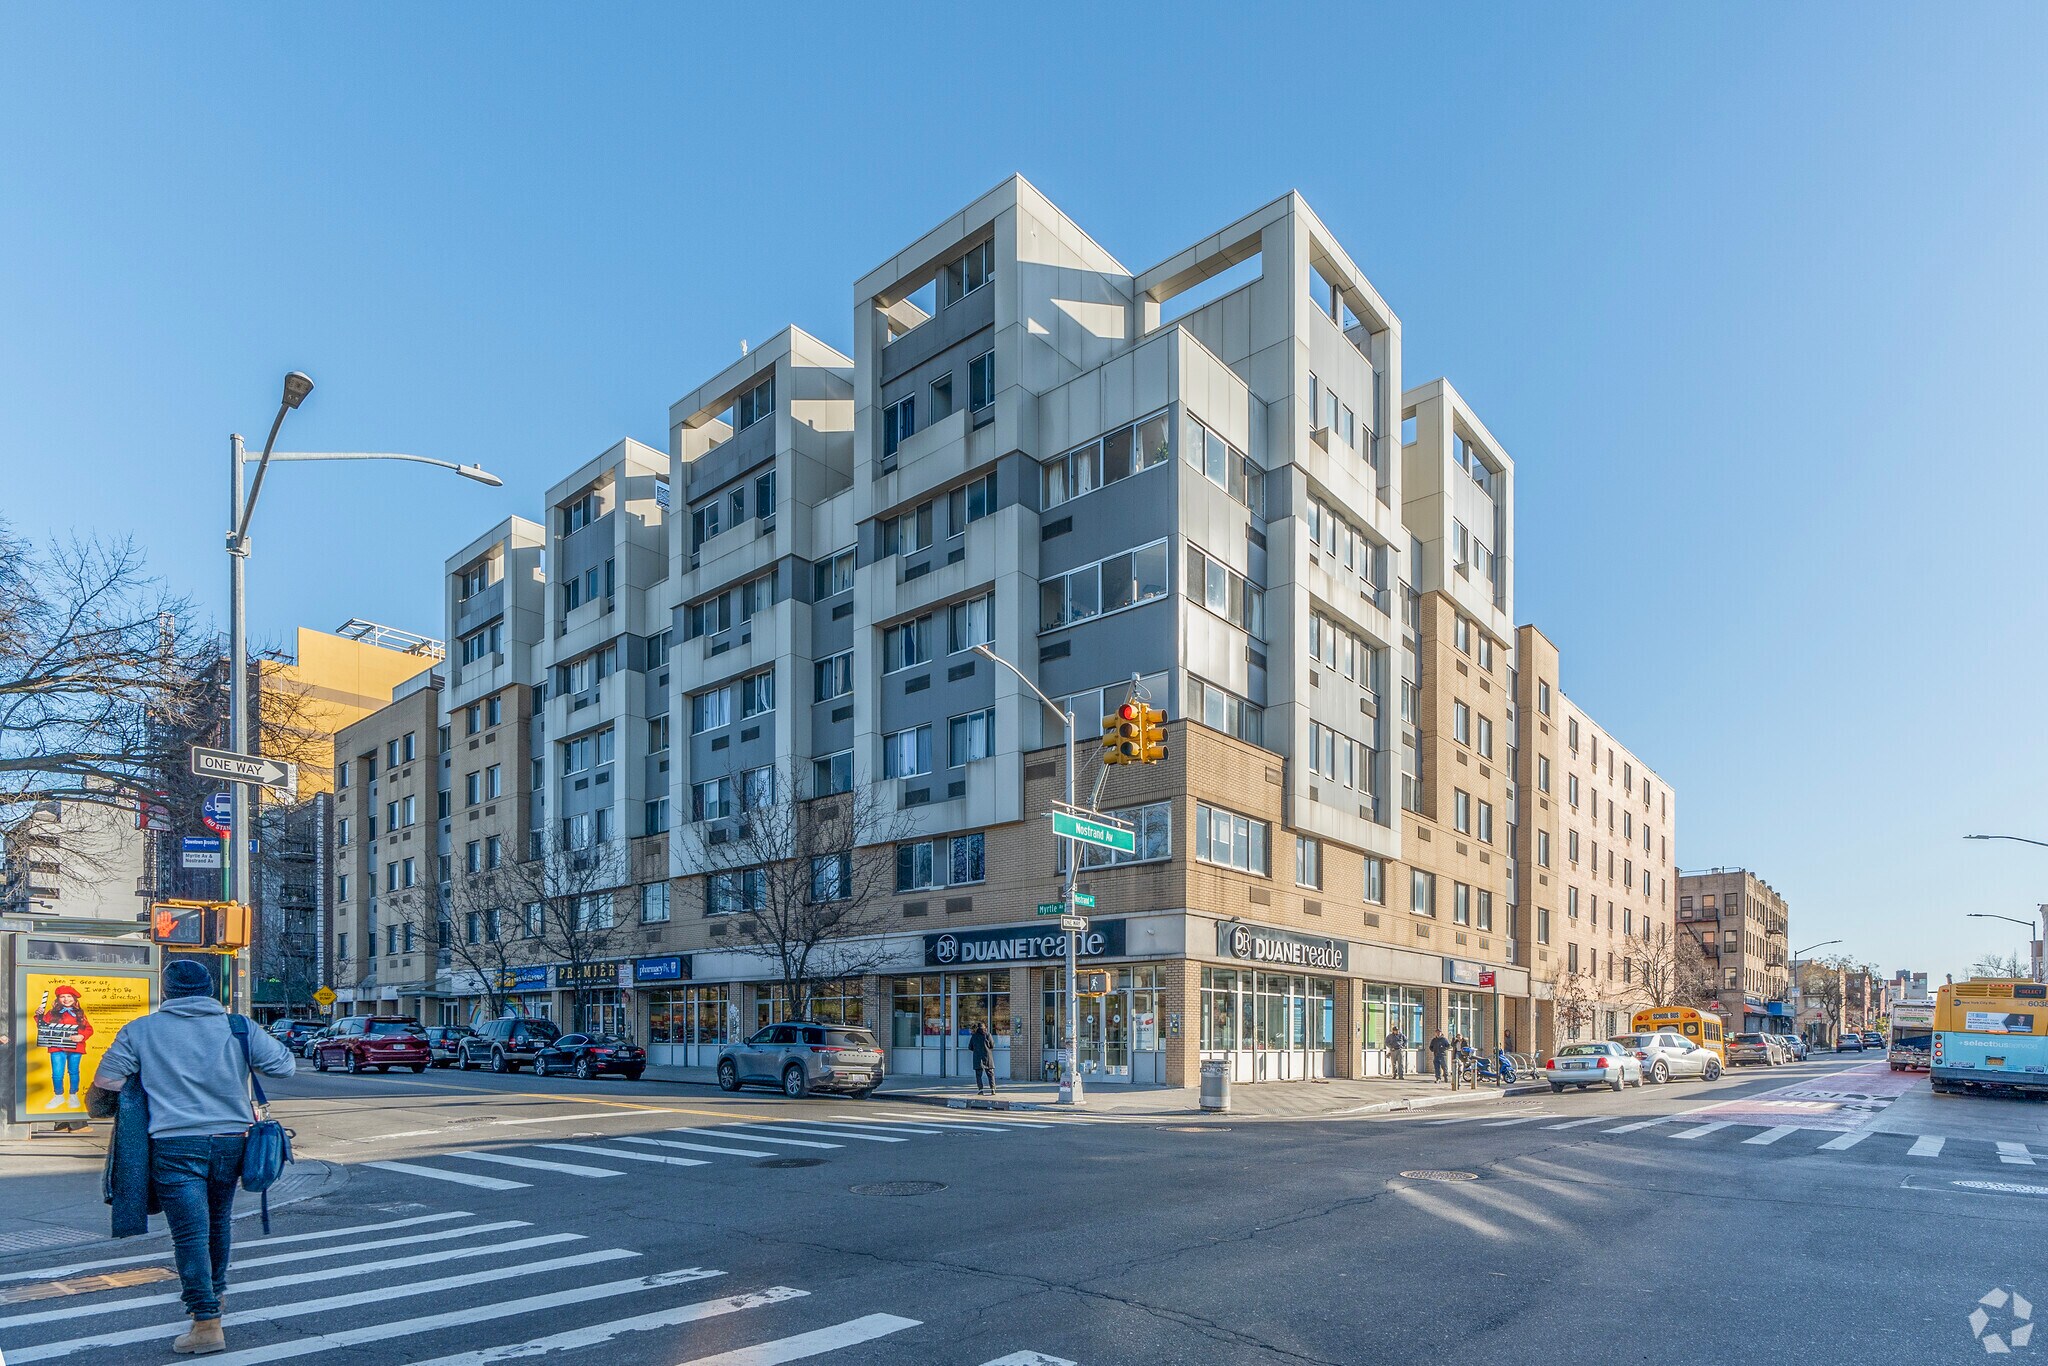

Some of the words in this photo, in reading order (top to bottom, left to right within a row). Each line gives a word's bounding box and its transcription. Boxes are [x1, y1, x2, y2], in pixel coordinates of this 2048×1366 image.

[205, 757, 232, 770] ONE
[236, 762, 262, 776] WAY
[206, 818, 216, 827] NO
[1075, 822, 1104, 840] Nostrand
[1106, 831, 1114, 842] Av
[1040, 904, 1058, 915] Myrtle
